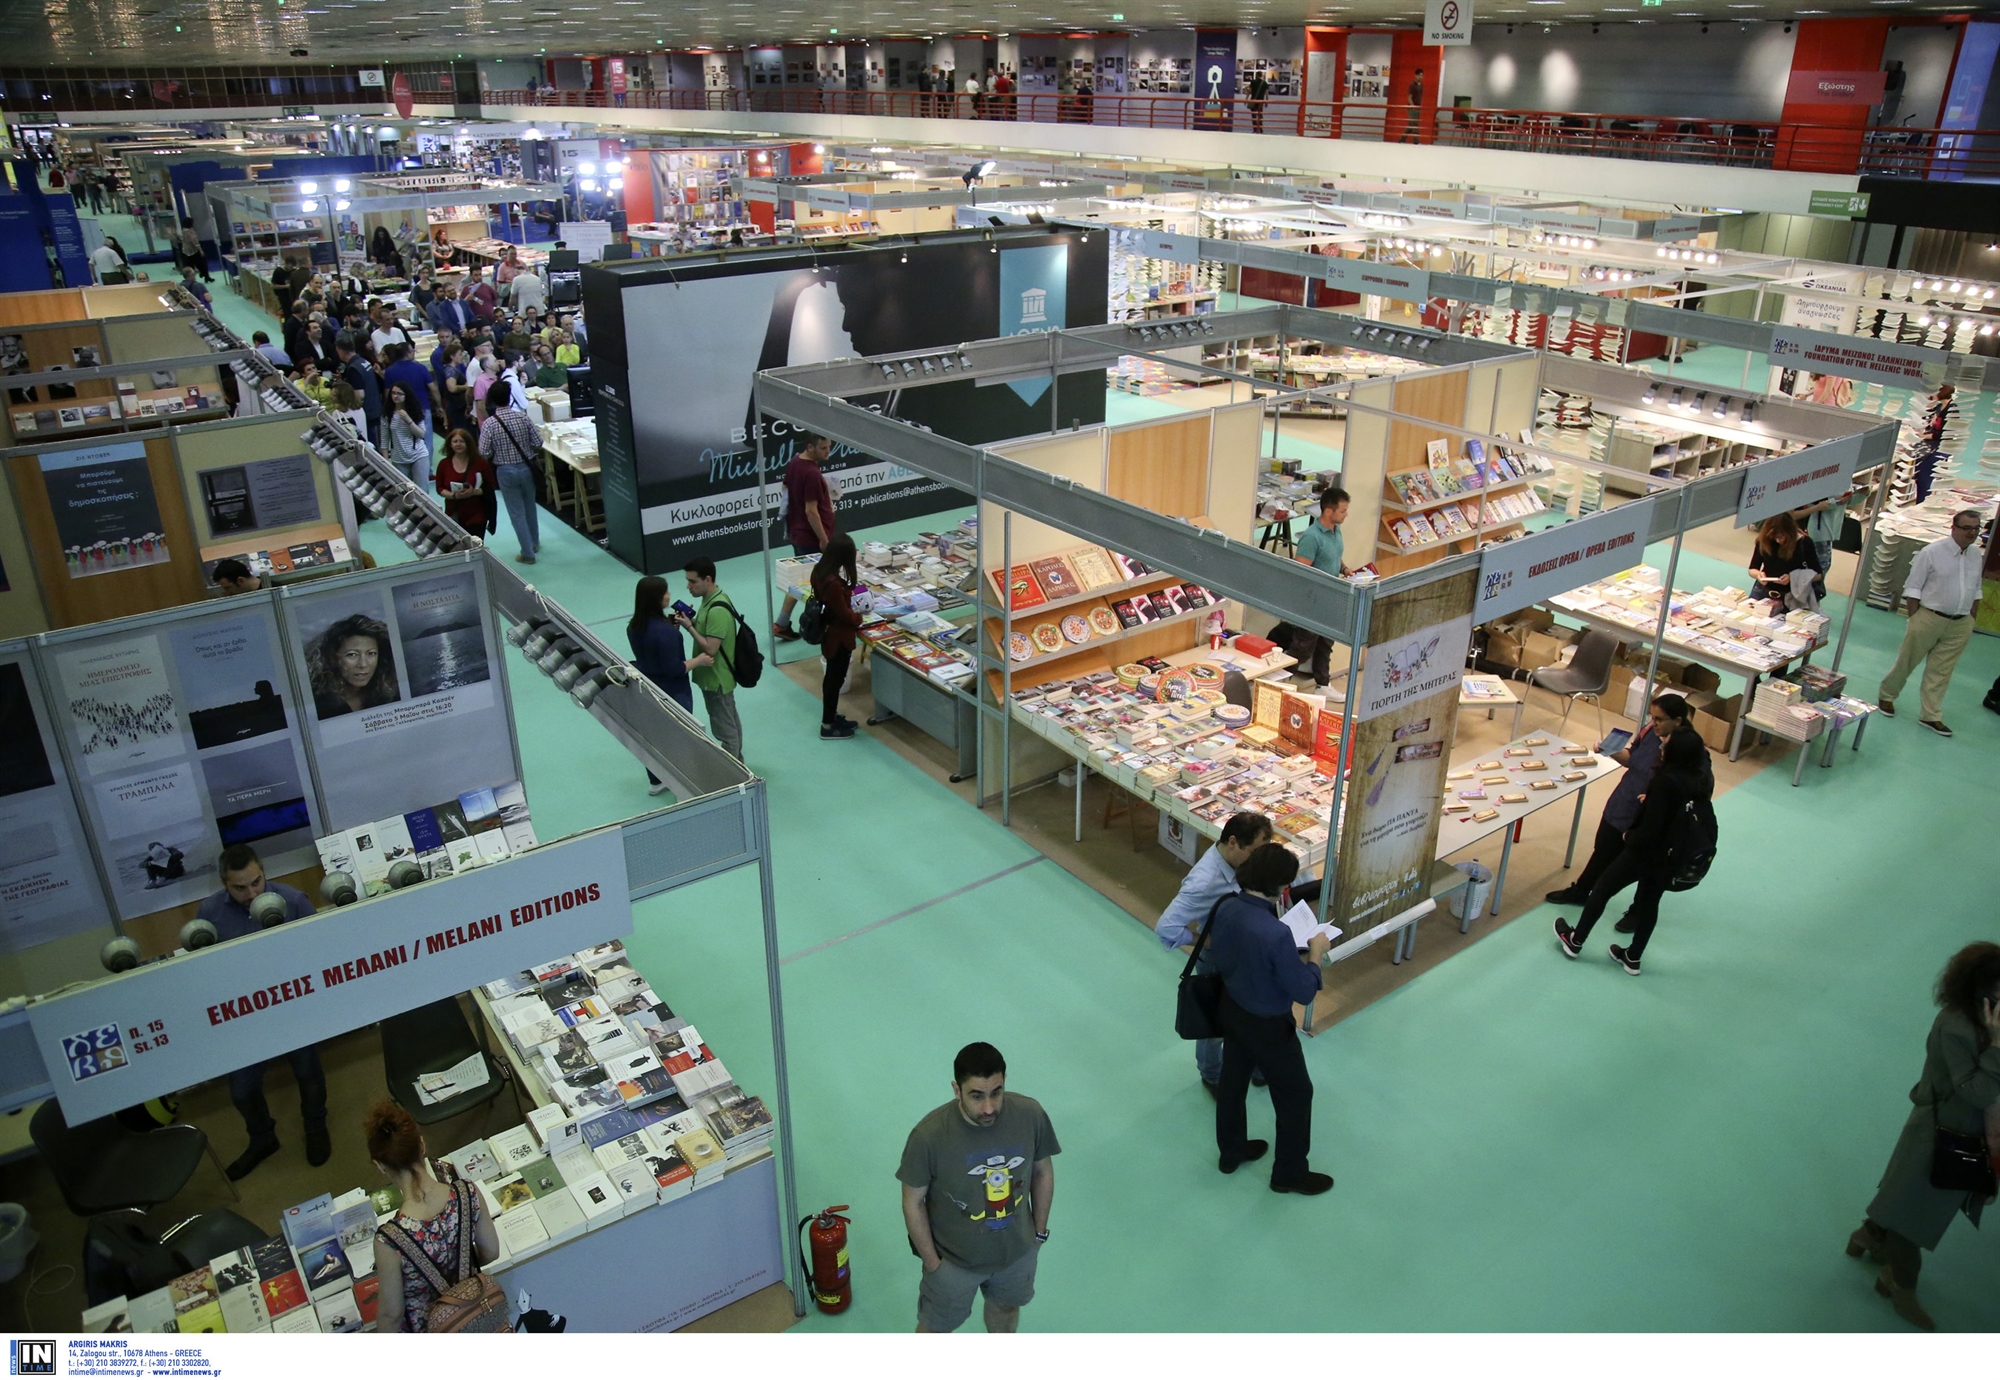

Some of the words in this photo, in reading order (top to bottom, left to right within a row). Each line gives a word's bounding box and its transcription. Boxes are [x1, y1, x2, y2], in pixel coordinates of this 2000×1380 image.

[1431, 32, 1440, 40] NO
[1441, 32, 1465, 40] SMOKING
[1818, 81, 1856, 93] Εξώστης
[1804, 351, 1845, 365] FOUNDATION
[1845, 358, 1854, 367] OF
[1855, 359, 1867, 369] THE
[1869, 362, 1901, 375] HELLENIC
[1903, 368, 1927, 379] WOR
[1814, 344, 1840, 356] ΙΔΡΥΜΑ
[1841, 348, 1876, 361] ΜΕΙΖΟΝΟΣ
[1877, 354, 1922, 369] ΕΛΛΗΝΙΣΜΟΥ
[80, 469, 116, 480] Μπορούμε
[68, 491, 134, 508] δημοσκοπήσεις
[670, 495, 754, 524] Κυκλοφορεί
[865, 470, 887, 486] την
[1528, 556, 1558, 579] ΕΚΔΟΣΕΙΣ
[1559, 550, 1579, 570] OPERA
[1585, 542, 1606, 562] OPERA
[1607, 531, 1636, 554] EDITIONS
[1037, 560, 1065, 574] ΚΑΡΟΛΟΣ
[79, 678, 101, 689] ΜΙΑΣ
[101, 668, 152, 684] ΕΠΙΣΤΡΟΦΗΣ
[87, 662, 140, 680] ΗΜΕΡΟΛΟΓΙΟ
[1371, 692, 1402, 711] ΓΙΟΡΤΗ
[1403, 686, 1418, 699] ΤΗΣ
[1419, 671, 1457, 692] ΜΗΤΕΡΑΣ
[361, 711, 383, 723] Διάλεξη
[383, 709, 394, 719] της
[394, 701, 431, 714] Μπαρμπαρά
[364, 716, 393, 729] Σάββατο
[399, 709, 420, 721] Μαΐου
[421, 706, 435, 716] στις
[435, 702, 453, 712] 16:20
[110, 782, 133, 793] ΧΡΗΣΤΟΣ
[118, 781, 175, 802] ΤΡΑΜΠΑΛΑ
[237, 793, 253, 801] ΠΕΡΑ
[253, 789, 272, 798] ΜΕΡΗ
[1396, 808, 1419, 822] ΠΑΝΤΑ
[1, 887, 9, 896] Η
[9, 877, 50, 894] ΕΚΔΙΚΗΣΗ
[4, 892, 20, 902] ΤΗΣ
[20, 880, 70, 898] ΓΕΩΓΡΑΦΙΑΣ
[206, 974, 316, 1026] ΕΚΔΟΣΕΙΣ
[322, 945, 407, 988] ΜΕΛΑΝΙ
[413, 940, 420, 960] /
[425, 914, 503, 955] MELANI
[510, 882, 601, 928] EDITIONS
[128, 1026, 144, 1039] Π.
[147, 1019, 165, 1032] 15
[133, 1040, 152, 1054] St.
[152, 1034, 170, 1047] 13
[702, 1289, 723, 1302] ΑΘΗΝΑ
